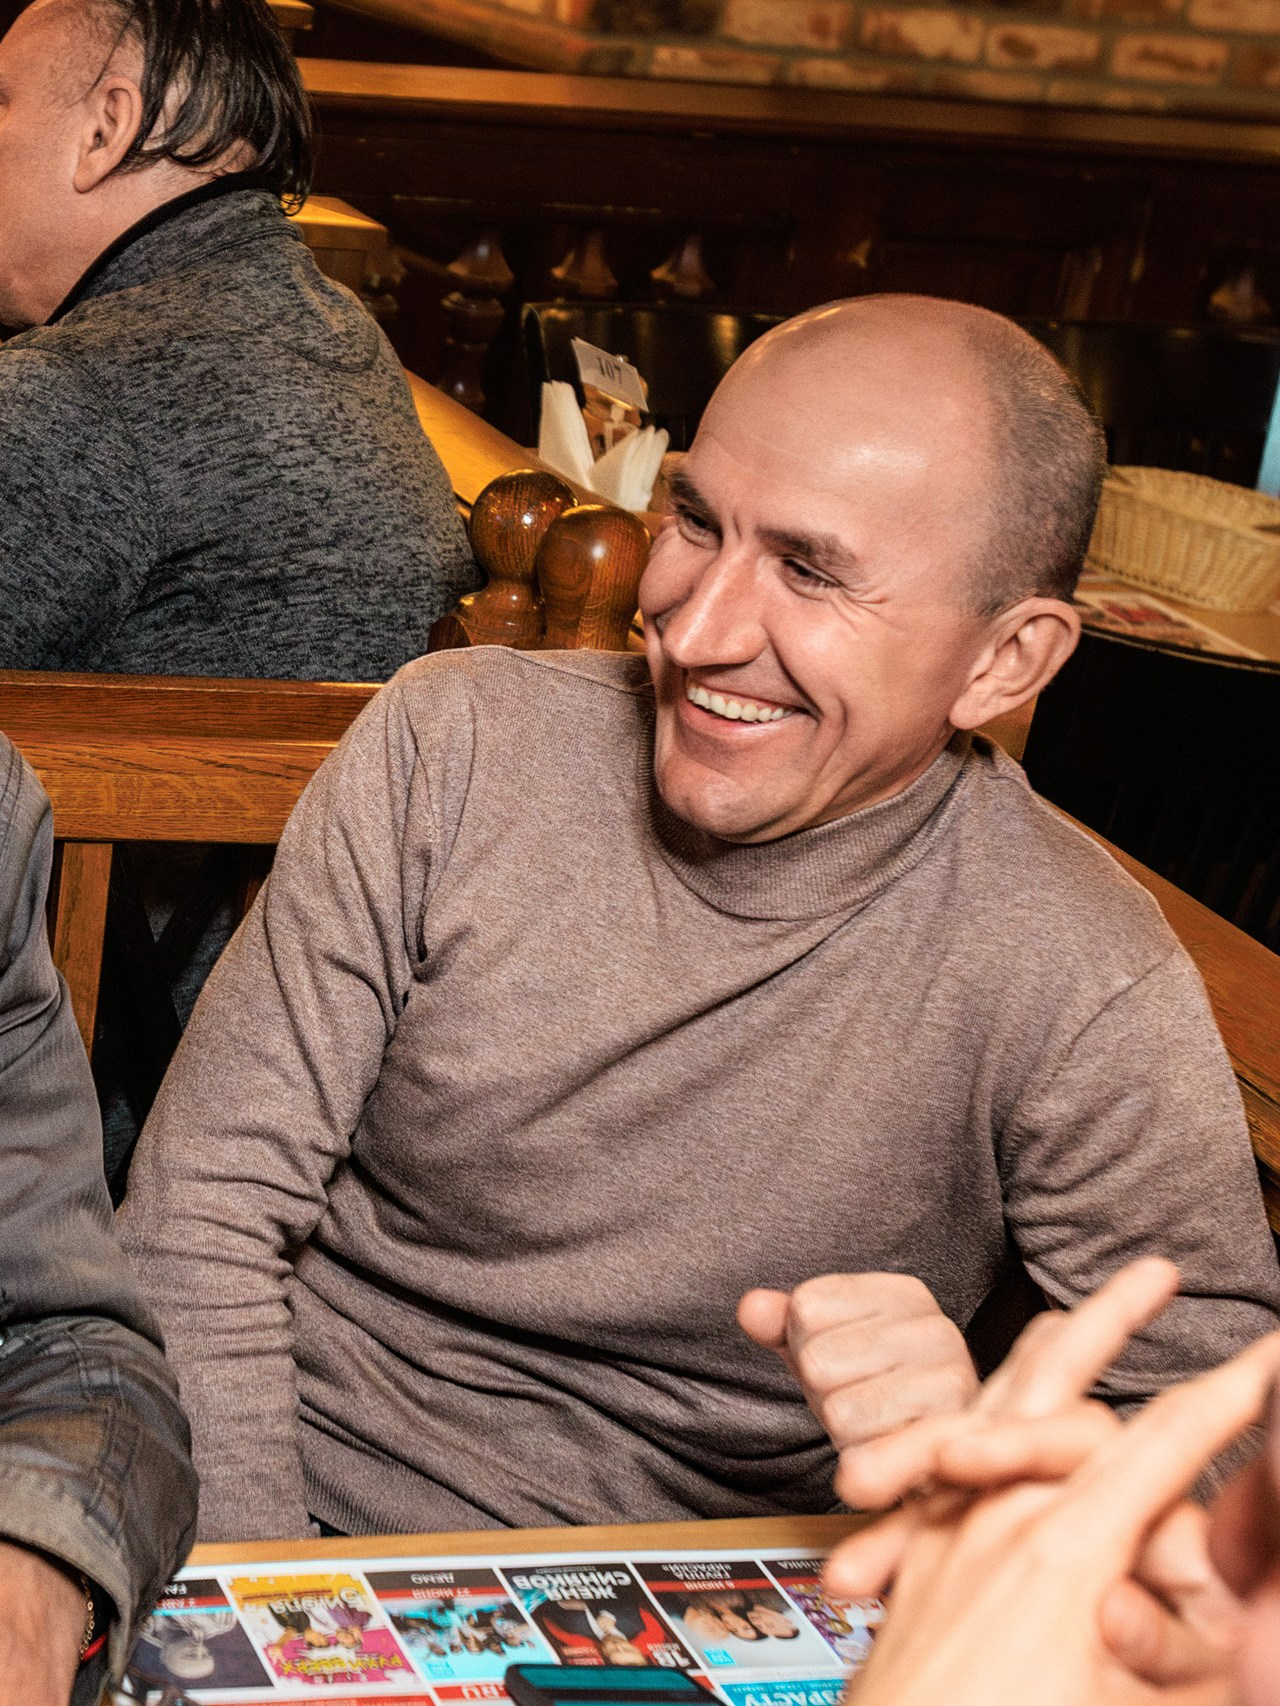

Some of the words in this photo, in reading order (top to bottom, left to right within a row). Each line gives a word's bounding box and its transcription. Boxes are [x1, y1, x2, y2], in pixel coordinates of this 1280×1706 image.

[596, 357, 624, 385] 107
[410, 1572, 455, 1585] ДЕМО
[512, 1571, 632, 1590] СИНЯКОВ
[544, 1584, 618, 1601] ЖЕНЯ
[348, 1653, 404, 1671] РУКИ
[651, 1650, 690, 1667] 18
